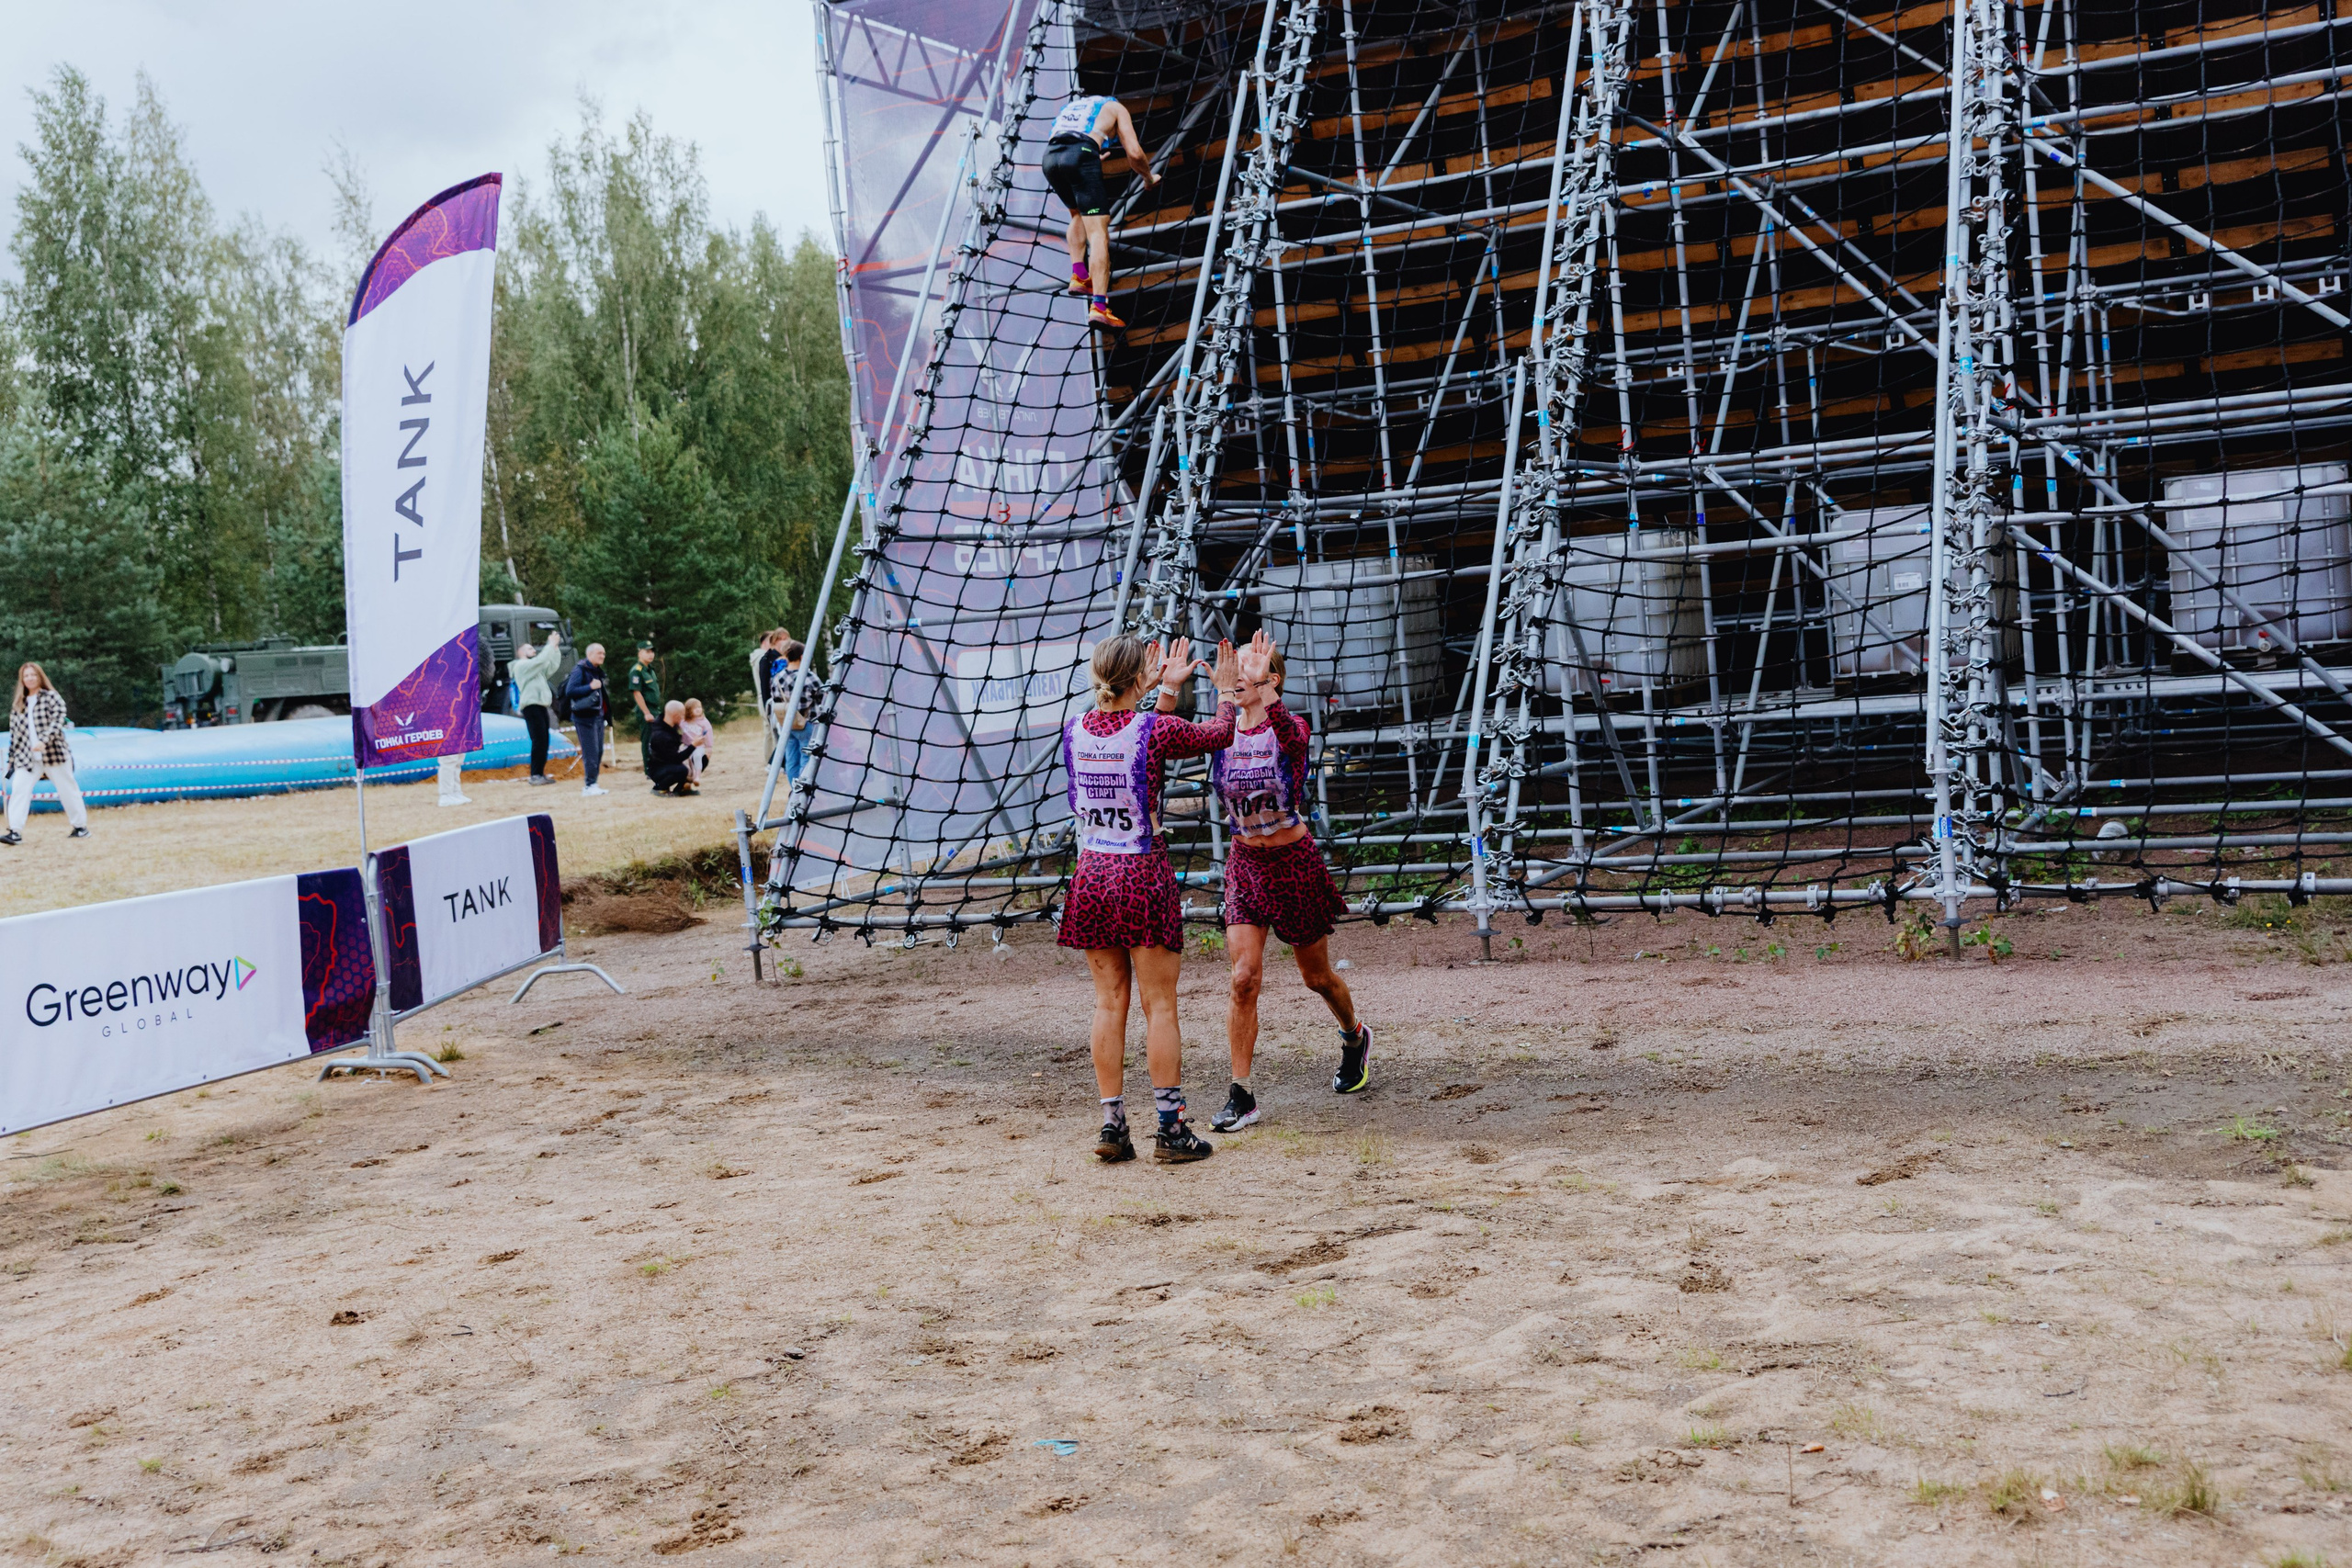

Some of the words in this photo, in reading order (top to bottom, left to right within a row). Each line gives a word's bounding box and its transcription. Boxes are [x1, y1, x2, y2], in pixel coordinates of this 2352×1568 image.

[393, 360, 435, 583] TANK
[375, 735, 403, 750] ГОНКА
[404, 729, 444, 744] ГЕРОЕВ
[1078, 751, 1097, 760] ГОНКА
[1079, 773, 1125, 787] МАССОВЫЙ
[1228, 767, 1273, 781] МАССОВЫЙ
[1088, 787, 1114, 798] СТАРТ
[1239, 780, 1263, 790] СТАРТ
[1230, 795, 1280, 818] 1074
[443, 875, 513, 924] TANK
[26, 959, 233, 1027] Greenway
[101, 1008, 193, 1038] GLOBAL
